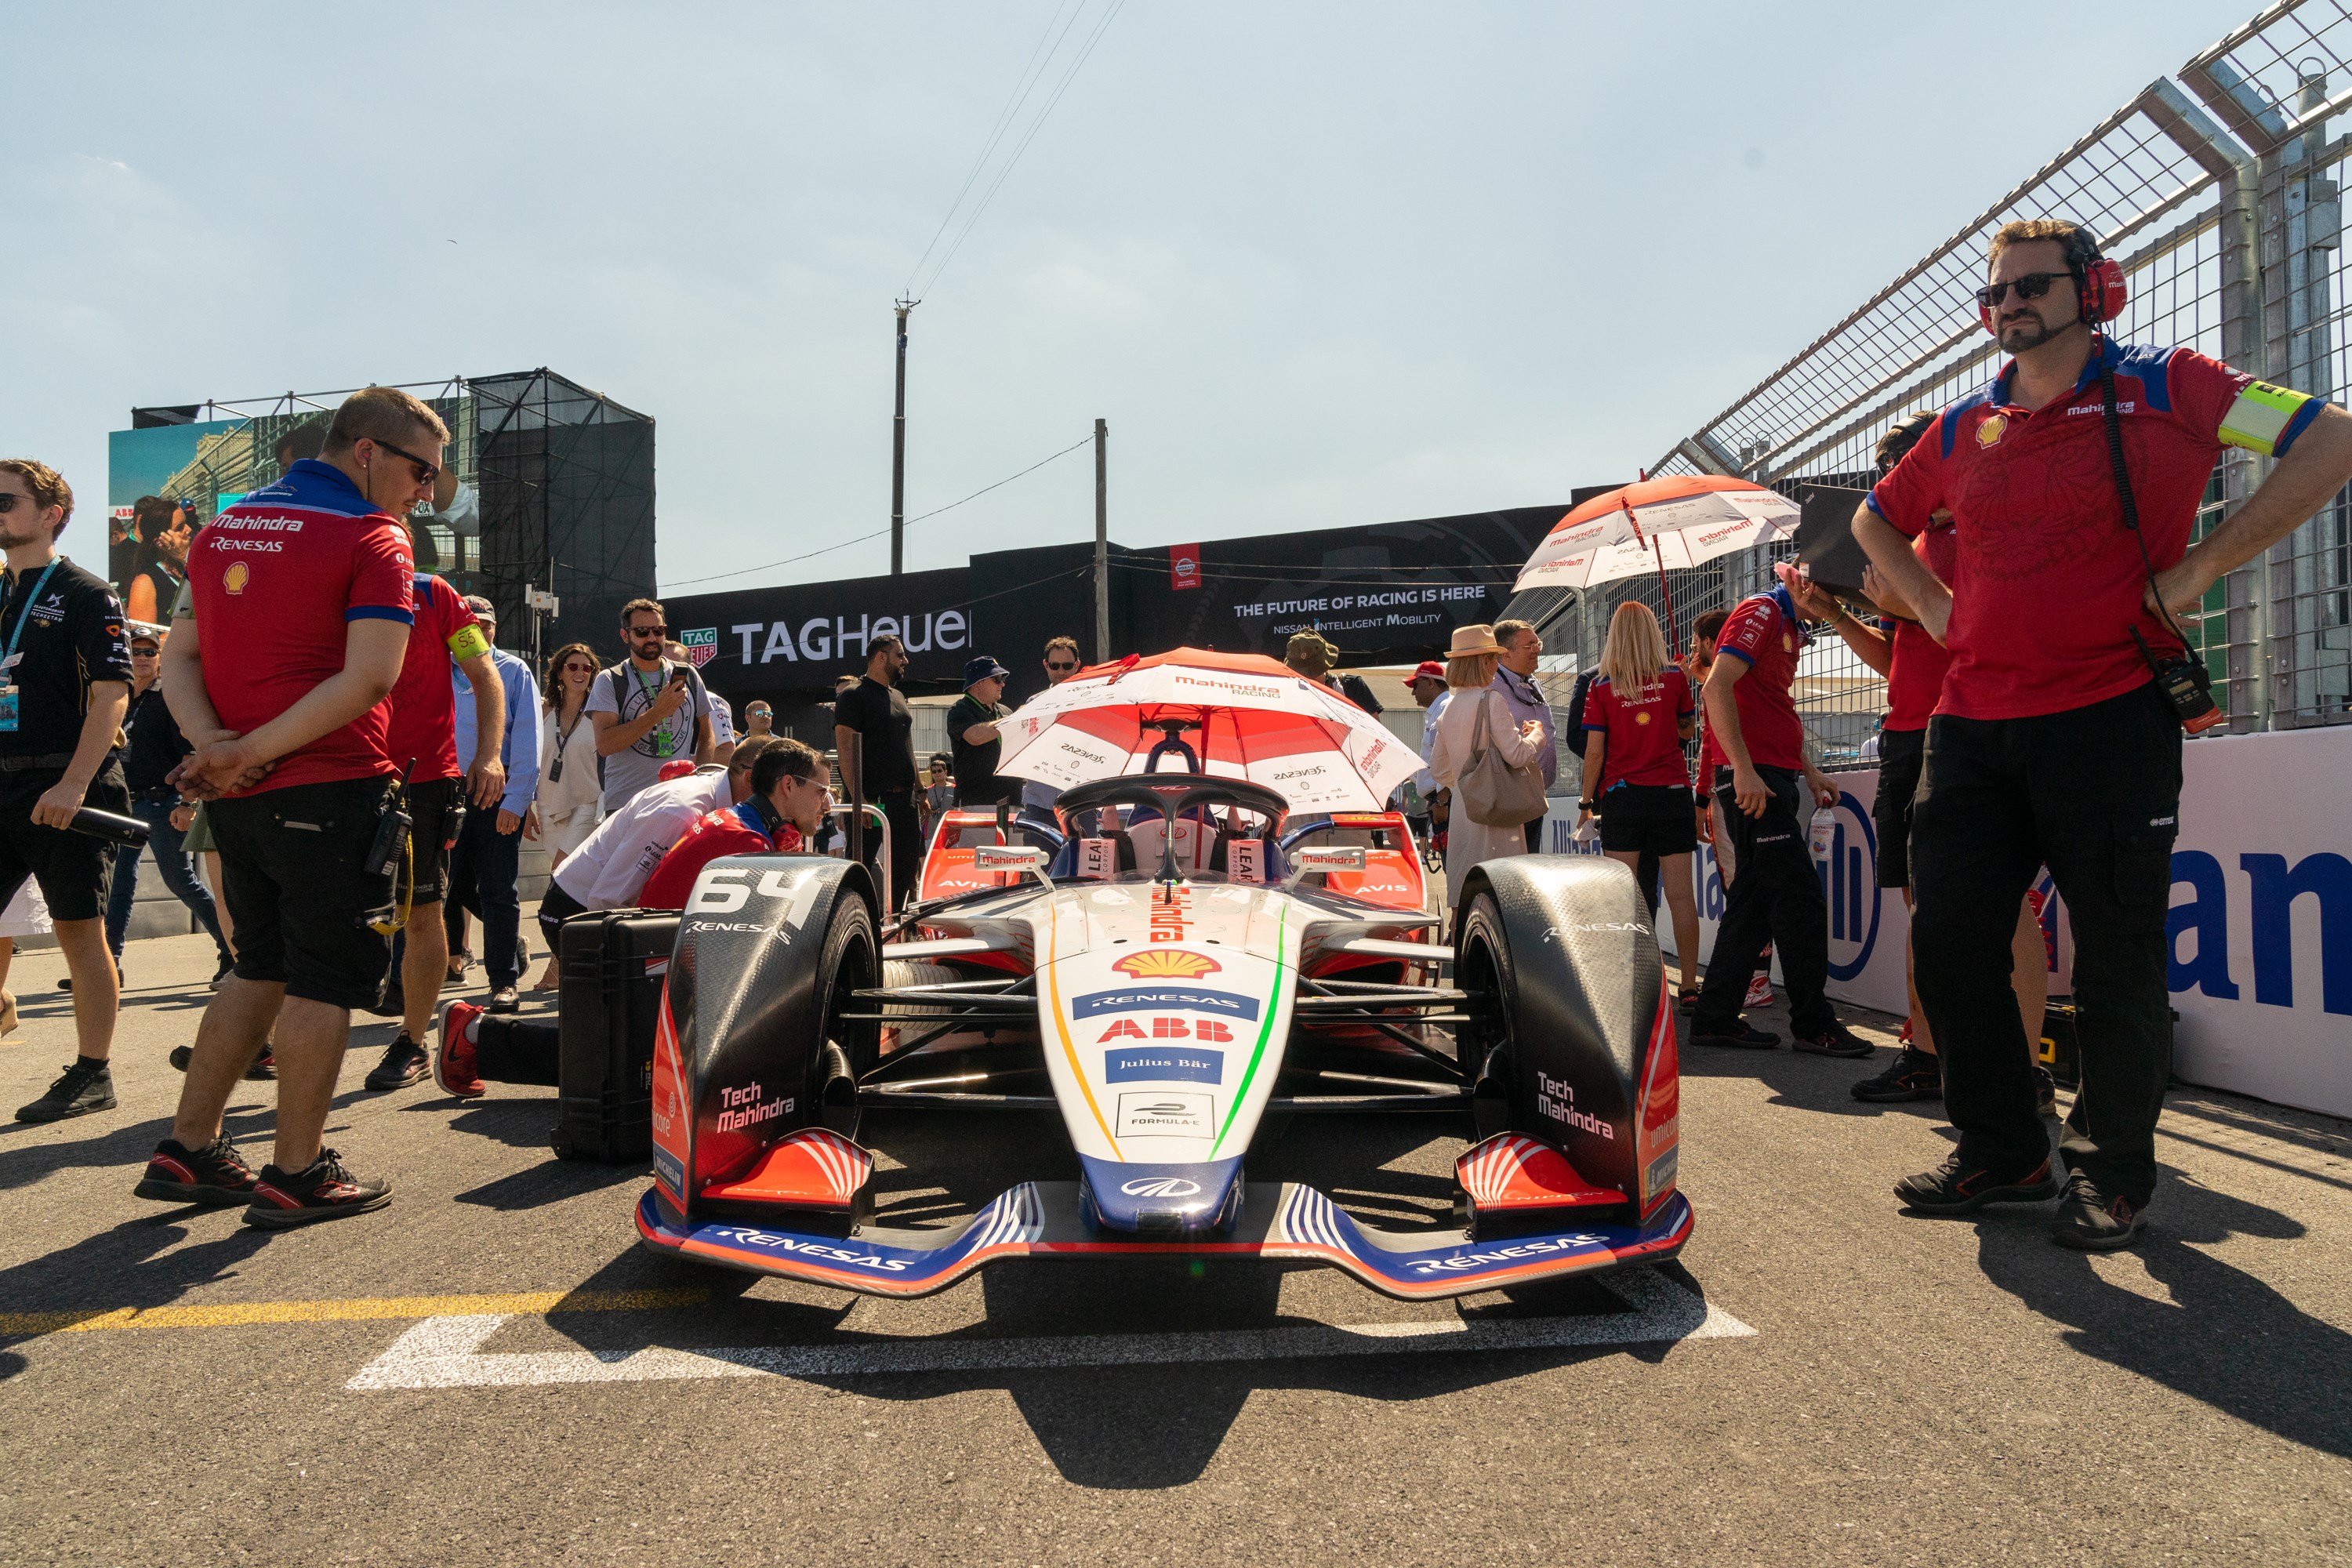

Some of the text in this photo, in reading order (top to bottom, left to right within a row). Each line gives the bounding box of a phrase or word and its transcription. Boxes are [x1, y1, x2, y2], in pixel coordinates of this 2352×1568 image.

[115, 508, 133, 517] ABB
[212, 514, 304, 532] Mahindra
[210, 536, 284, 552] RENESAS
[1549, 526, 1604, 547] Mahindra
[1575, 532, 1602, 543] RACING
[1234, 585, 1486, 617] THE FUTURE OF RACING IS HERE
[1314, 617, 1384, 631] INTELLIGENT
[1386, 614, 1442, 626] MOBILITY
[459, 632, 476, 648] S5
[684, 631, 714, 644] TAG
[690, 646, 715, 666] EUER
[1175, 676, 1280, 694] Mahindra
[1232, 689, 1281, 699] RACING
[1621, 696, 1662, 707] RENESAS
[676, 730, 686, 745] TIME
[637, 743, 652, 753] GEA
[1757, 833, 1791, 844] Mahindra
[982, 856, 1035, 865] Mahindra
[1240, 847, 1253, 880] LEAR
[1302, 855, 1356, 864] Mahindra
[938, 880, 992, 889] AVIS
[1354, 884, 1408, 895] AVIS
[684, 869, 823, 931] 64
[1150, 887, 1194, 942] Mahindra
[685, 920, 792, 946] RENESAS
[1092, 994, 1240, 1009] RENESAS
[1096, 1018, 1234, 1044] ABB
[1120, 1058, 1211, 1069] Julius Bär
[721, 1081, 761, 1109] Tech
[1537, 1071, 1573, 1102] Tech
[717, 1097, 795, 1134] Mahindra
[1538, 1094, 1614, 1140] Mahindra
[657, 1156, 681, 1187] MICHELIN
[717, 1227, 916, 1272] RENESAS
[1406, 1233, 1610, 1274] RENESAS
